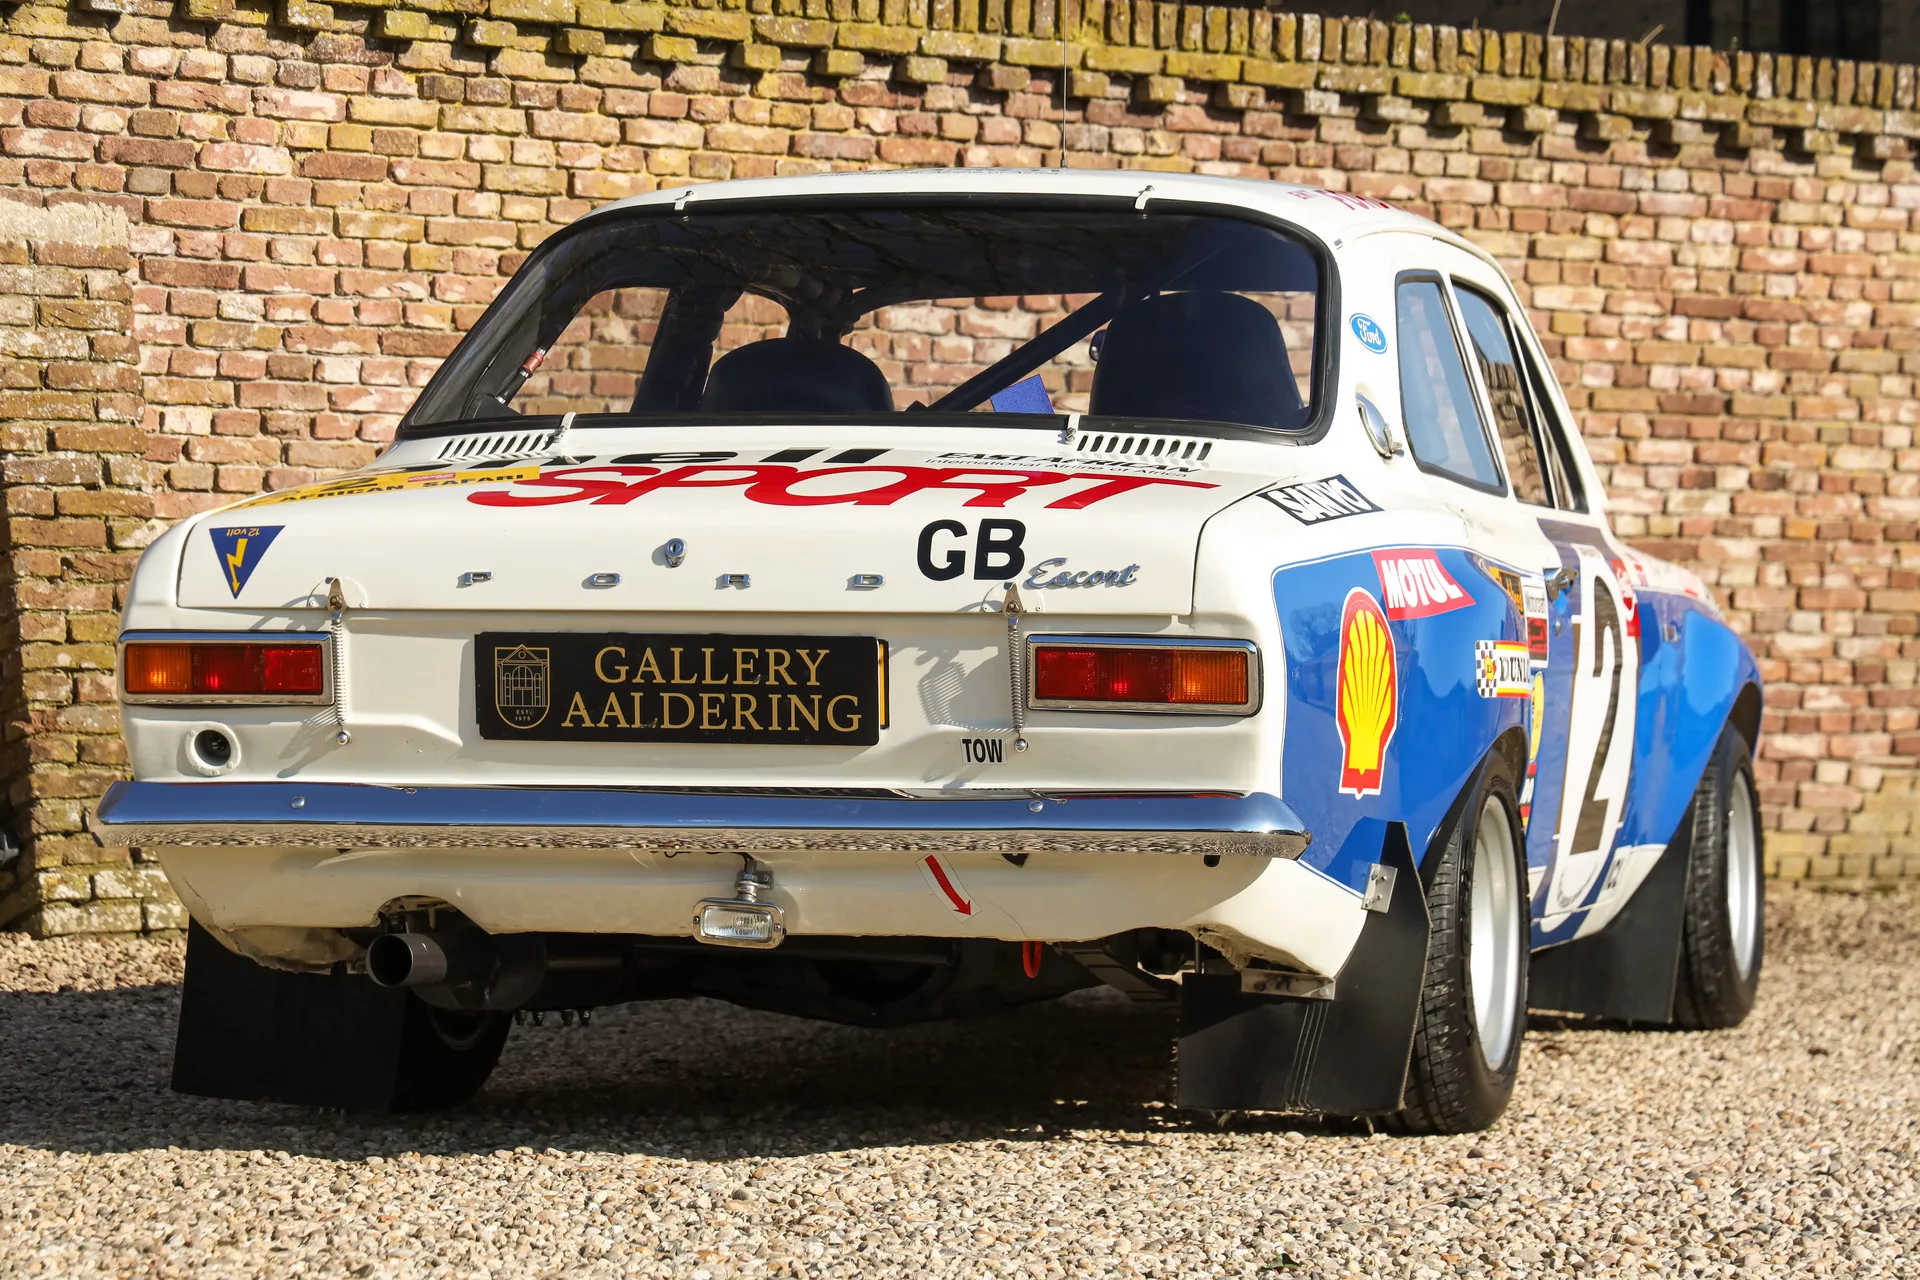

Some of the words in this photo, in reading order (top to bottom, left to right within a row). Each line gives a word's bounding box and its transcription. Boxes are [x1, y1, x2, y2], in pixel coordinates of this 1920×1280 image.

[1357, 317, 1382, 347] Ford
[925, 459, 1041, 467] International
[1044, 463, 1103, 471] Airline
[1134, 468, 1188, 478] Africa
[937, 452, 1036, 461] EAST
[1035, 456, 1202, 473] AFRICAN
[280, 484, 404, 502] AFRICAN
[422, 474, 524, 488] SAFARI
[467, 465, 1221, 509] SPORT
[1266, 478, 1373, 521] SANYO
[226, 528, 247, 537] volt
[248, 527, 261, 537] 12
[917, 518, 1027, 581] GB
[1026, 557, 1140, 586] Escort
[1380, 558, 1464, 609] MOTUL
[594, 646, 830, 686] GALLERY
[1499, 656, 1531, 683] DUNL
[561, 691, 862, 732] AALDERING
[1571, 575, 1623, 856] 2
[961, 738, 1003, 763] TOW
